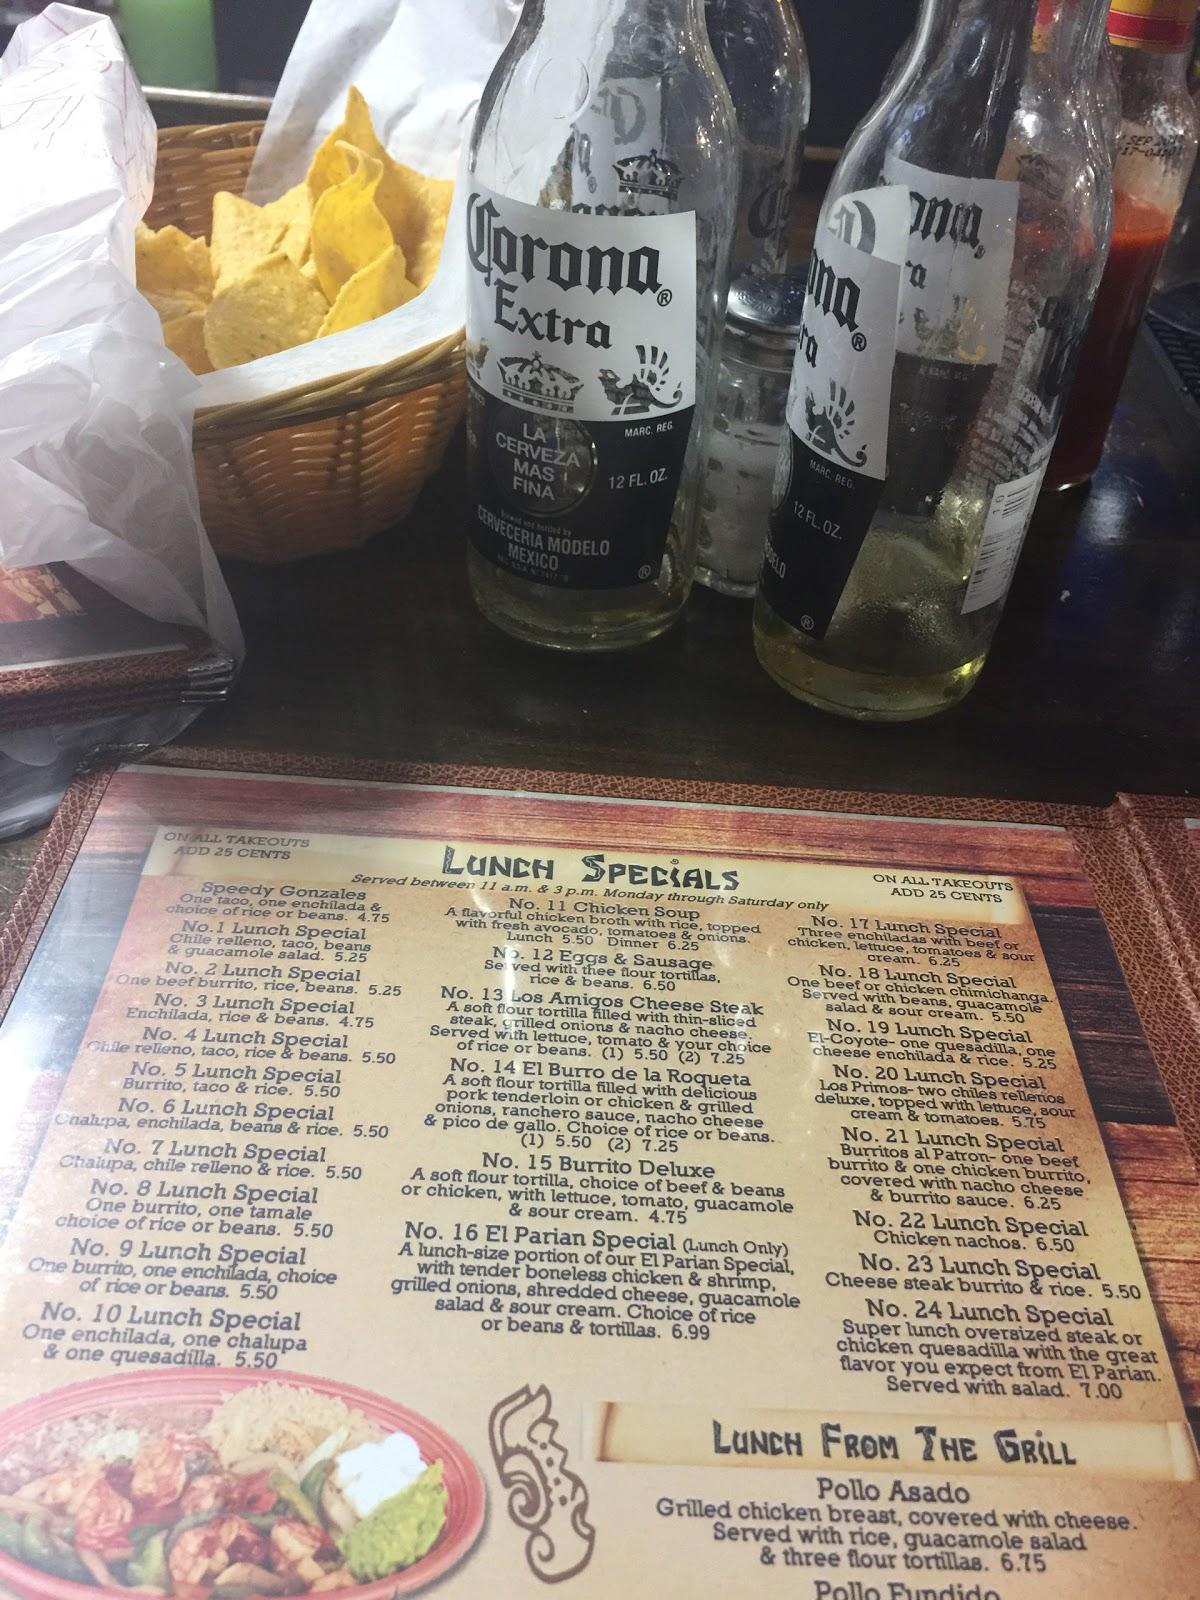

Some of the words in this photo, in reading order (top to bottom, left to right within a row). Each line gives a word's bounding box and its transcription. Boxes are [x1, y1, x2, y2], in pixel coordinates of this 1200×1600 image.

[467, 193, 662, 295] Corona
[494, 278, 613, 349] Extra
[523, 423, 546, 443] LA
[496, 432, 580, 467] CERVEZA
[513, 459, 555, 482] MAS
[609, 476, 624, 489] 12
[629, 473, 647, 487] FL.
[650, 468, 668, 484] OZ.
[513, 477, 555, 500] FINA
[478, 504, 543, 550] CERVECERIA
[548, 537, 610, 556] MODELO
[793, 501, 804, 519] 12
[806, 510, 820, 531] FL.
[823, 520, 843, 540] OZ.
[508, 543, 558, 571] MEXICO
[163, 831, 189, 842] ON
[190, 833, 222, 843] ALL
[225, 834, 310, 848] TAKEOUTS
[173, 845, 210, 856] ADD
[213, 847, 233, 857] 25
[236, 848, 291, 860] CENTS
[442, 845, 554, 880] LUNCH
[201, 881, 275, 898] Speedy
[279, 885, 367, 900] Gonzales
[351, 873, 408, 885] Served
[409, 876, 475, 889] between
[479, 881, 496, 891] 11
[501, 884, 531, 893] a.m.
[537, 884, 549, 894] &
[553, 887, 562, 895] 3
[565, 887, 597, 897] p.m.
[603, 887, 664, 902] Monday
[667, 892, 724, 905] through
[730, 895, 794, 910] Saturday
[797, 901, 829, 913] only
[872, 873, 897, 884] ON
[900, 875, 930, 886] ALL
[931, 877, 1014, 891] TAKEOUTS
[890, 887, 925, 898] ADD
[929, 889, 946, 899] 25
[950, 890, 1003, 903] CENTS
[166, 904, 218, 915] choice
[221, 906, 239, 916] of
[241, 905, 272, 917] rice
[275, 910, 294, 918] or
[297, 908, 348, 921] beans.
[357, 911, 390, 923] 4.75
[180, 893, 214, 904] One
[217, 896, 253, 907] taco,
[257, 898, 287, 907] one
[290, 899, 366, 911] enchilada
[369, 902, 382, 912] &
[506, 930, 553, 943] Lunch
[562, 933, 594, 945] 5.50
[607, 936, 659, 949] Dinner
[667, 939, 699, 951] 6.25
[819, 964, 852, 978] No.
[858, 966, 880, 979] 18
[884, 968, 943, 983] Lunch
[945, 972, 1017, 990] Special
[126, 1007, 212, 1023] Enchilada,
[218, 1009, 251, 1023] rice
[255, 1011, 269, 1023] &
[274, 1012, 329, 1026] beans.
[338, 1015, 374, 1028] 4.75
[153, 992, 187, 1007] No.
[195, 994, 208, 1008] 3
[211, 994, 274, 1011] Lunch
[278, 997, 355, 1017] Special
[450, 1057, 484, 1073] No.
[493, 1059, 516, 1074] 14
[523, 1060, 543, 1076] El
[548, 1062, 605, 1079] Burro
[611, 1066, 638, 1081] de
[644, 1067, 662, 1082] la
[668, 1068, 751, 1089] Roqueta
[482, 1151, 518, 1169] No.
[528, 1153, 552, 1171] 15
[560, 1155, 632, 1175] Burrito
[640, 1159, 715, 1178] Deluxe
[90, 1178, 128, 1196] No.
[136, 1179, 152, 1197] 8
[155, 1180, 227, 1200] Lunch
[232, 1183, 318, 1207] Special
[85, 1197, 126, 1212] One
[131, 1199, 201, 1218] burrito,
[208, 1205, 244, 1217] one
[249, 1202, 312, 1220] tamale
[508, 1202, 523, 1216] &
[528, 1206, 570, 1219] sour
[574, 1208, 638, 1222] cream.
[648, 1208, 687, 1224] 4.75
[854, 1209, 893, 1227] No.
[899, 1211, 926, 1229] 22
[930, 1213, 1001, 1232] Lunch
[1004, 1216, 1089, 1240] Special
[405, 1220, 443, 1240] No.
[453, 1223, 478, 1242] 16
[486, 1224, 508, 1243] El
[513, 1225, 586, 1246] Parian
[592, 1229, 676, 1255] Special
[682, 1237, 738, 1257] (Lunch
[742, 1240, 789, 1260] Only)
[873, 1229, 951, 1247] Chicken
[953, 1234, 1026, 1250] nachos.
[1035, 1236, 1075, 1252] 6.50
[40, 1301, 81, 1321] No.
[92, 1303, 122, 1323] 10
[126, 1304, 202, 1327] Lunch
[208, 1307, 301, 1335] Special
[866, 1298, 907, 1318] No.
[914, 1299, 943, 1319] 24
[947, 1301, 1021, 1322] Lunch
[1024, 1304, 1114, 1330] Special
[22, 1323, 66, 1341] One
[71, 1327, 175, 1348] enchilada,
[182, 1333, 221, 1347] one
[226, 1330, 307, 1354] chalupa
[481, 1318, 503, 1331] or
[507, 1315, 564, 1334] beans
[569, 1318, 584, 1335] &
[588, 1320, 660, 1338] tortillas.
[671, 1322, 710, 1340] 6.99
[42, 1342, 59, 1359] &
[65, 1347, 105, 1361] one
[109, 1346, 221, 1369] quesadilla.
[234, 1350, 278, 1369] 5.50
[886, 1374, 960, 1394] Served
[963, 1376, 1007, 1396] with
[1011, 1380, 1070, 1398] salad.
[1082, 1381, 1123, 1400] 7.00
[713, 1420, 803, 1456] LUNCH
[821, 1422, 900, 1460] FROM
[915, 1425, 978, 1461] THE
[816, 1476, 880, 1501] Pollo
[888, 1479, 971, 1504] Asado
[656, 1497, 732, 1519] Grilled
[738, 1501, 822, 1522] chicken
[827, 1503, 902, 1527] breast,
[907, 1508, 999, 1527] covered
[1002, 1509, 1050, 1529] with
[1053, 1510, 1138, 1531] cheese.
[759, 1545, 776, 1565] &
[782, 1546, 841, 1567] three
[846, 1547, 897, 1569] flour
[902, 1548, 989, 1572] tortillas.
[1000, 1552, 1047, 1573] 6.75
[814, 1580, 881, 1600] Pollo
